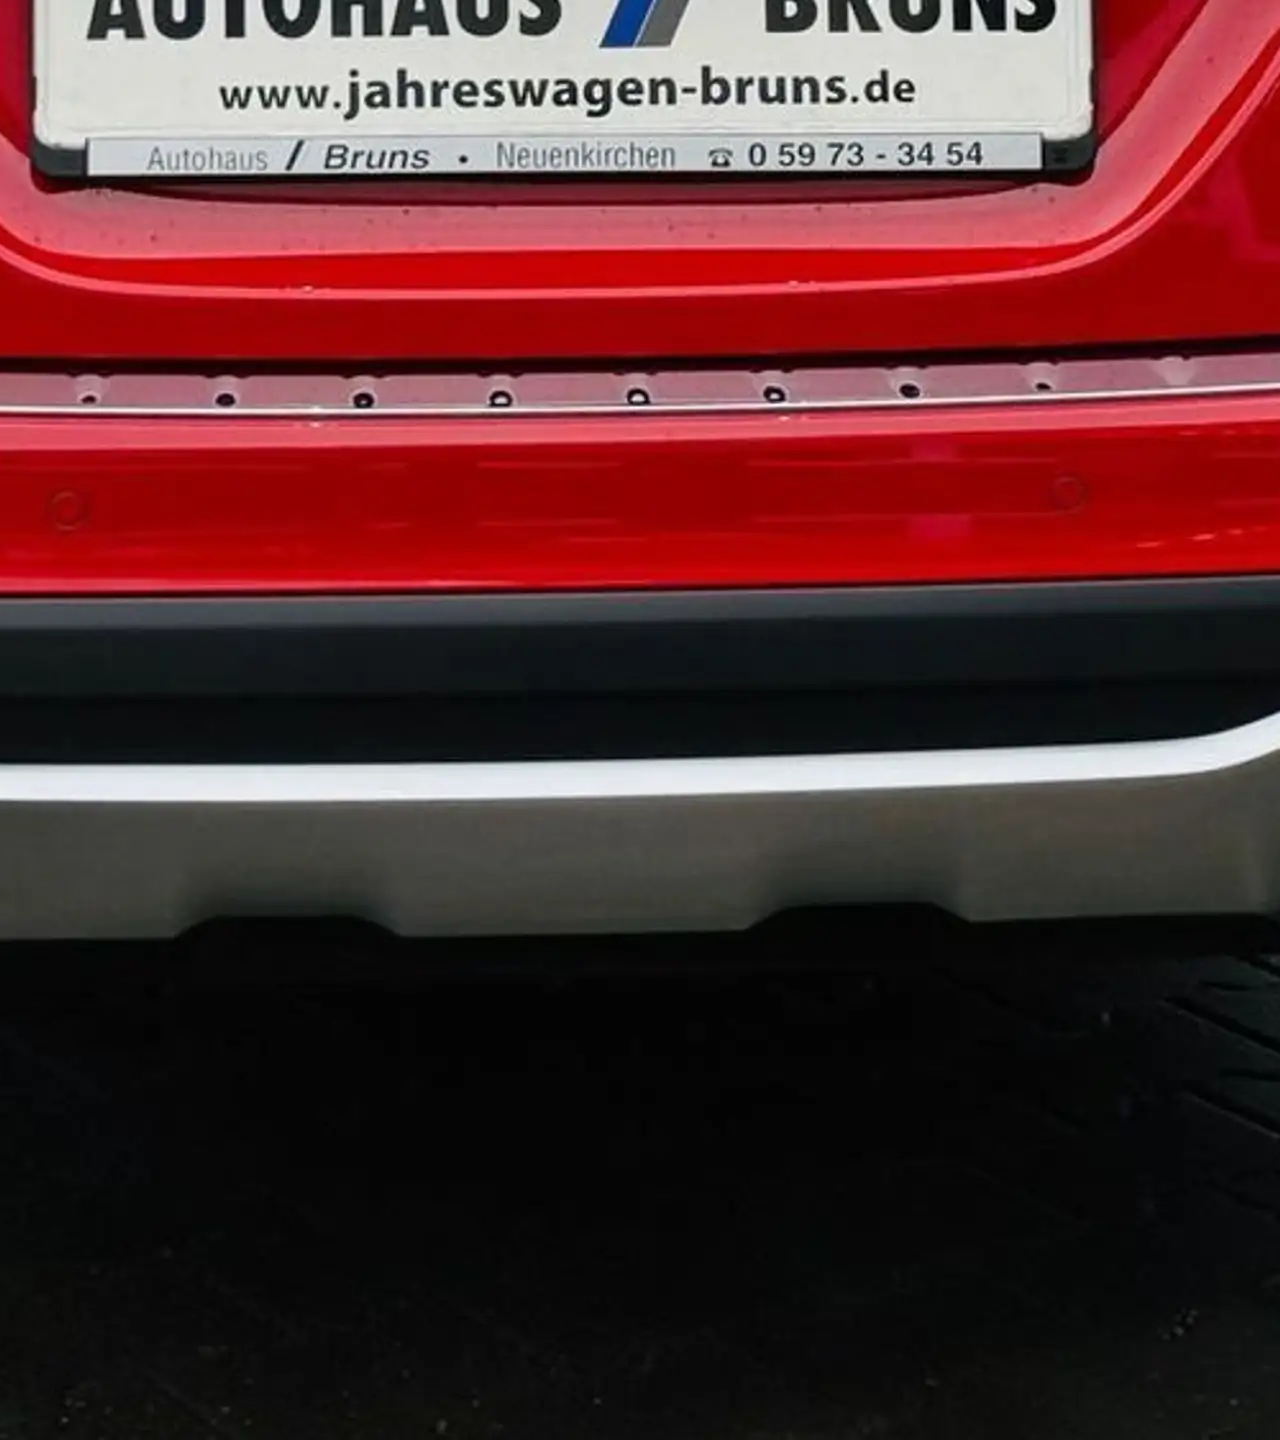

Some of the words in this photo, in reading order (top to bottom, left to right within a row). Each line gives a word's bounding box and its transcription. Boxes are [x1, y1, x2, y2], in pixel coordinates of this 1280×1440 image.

[218, 65, 917, 121] www.jahreswagen-bruns.de
[146, 145, 269, 172] Autohaus
[323, 143, 431, 170] Bruns
[495, 140, 677, 170] Neuenkirchen
[776, 142, 816, 167] 59
[826, 141, 865, 167] 73
[896, 141, 936, 167] 34
[945, 141, 984, 166] 54
